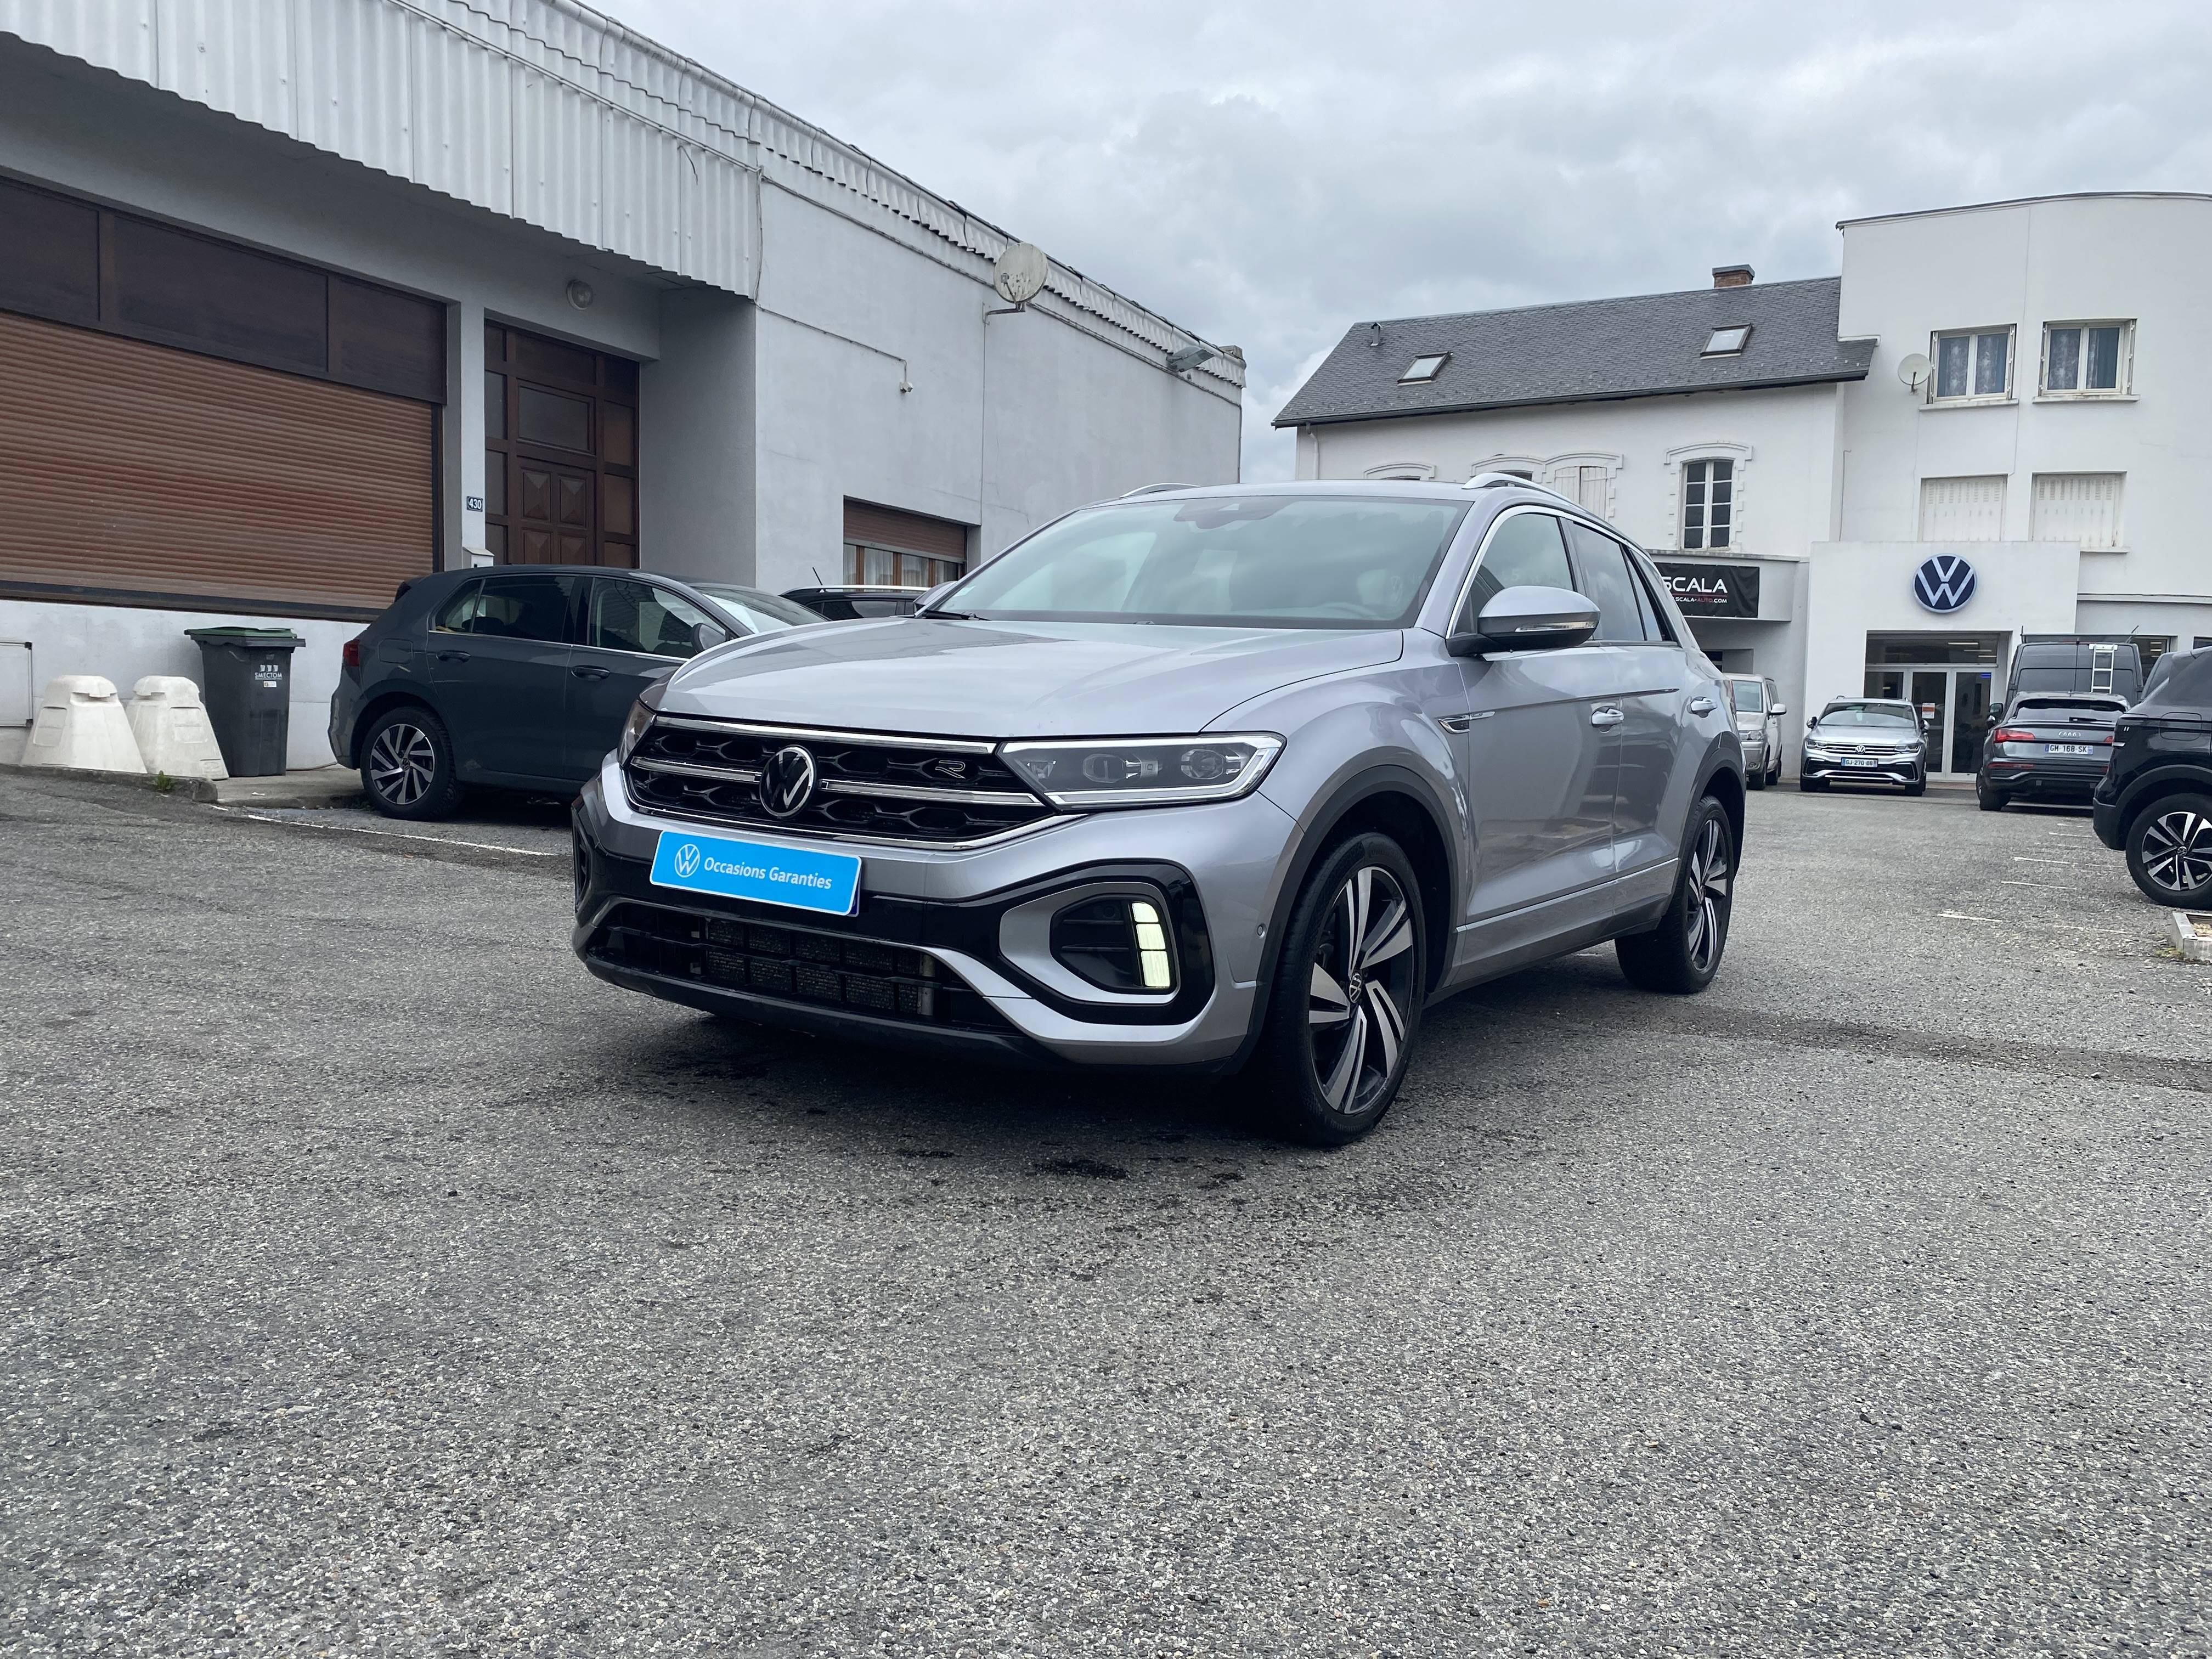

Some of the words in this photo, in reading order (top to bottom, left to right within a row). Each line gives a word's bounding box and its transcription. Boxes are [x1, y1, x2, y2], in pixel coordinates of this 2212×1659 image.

[469, 498, 481, 509] 430
[1661, 576, 1728, 593] SCALA
[704, 857, 766, 879] Occasions
[769, 866, 833, 890] Garanties
